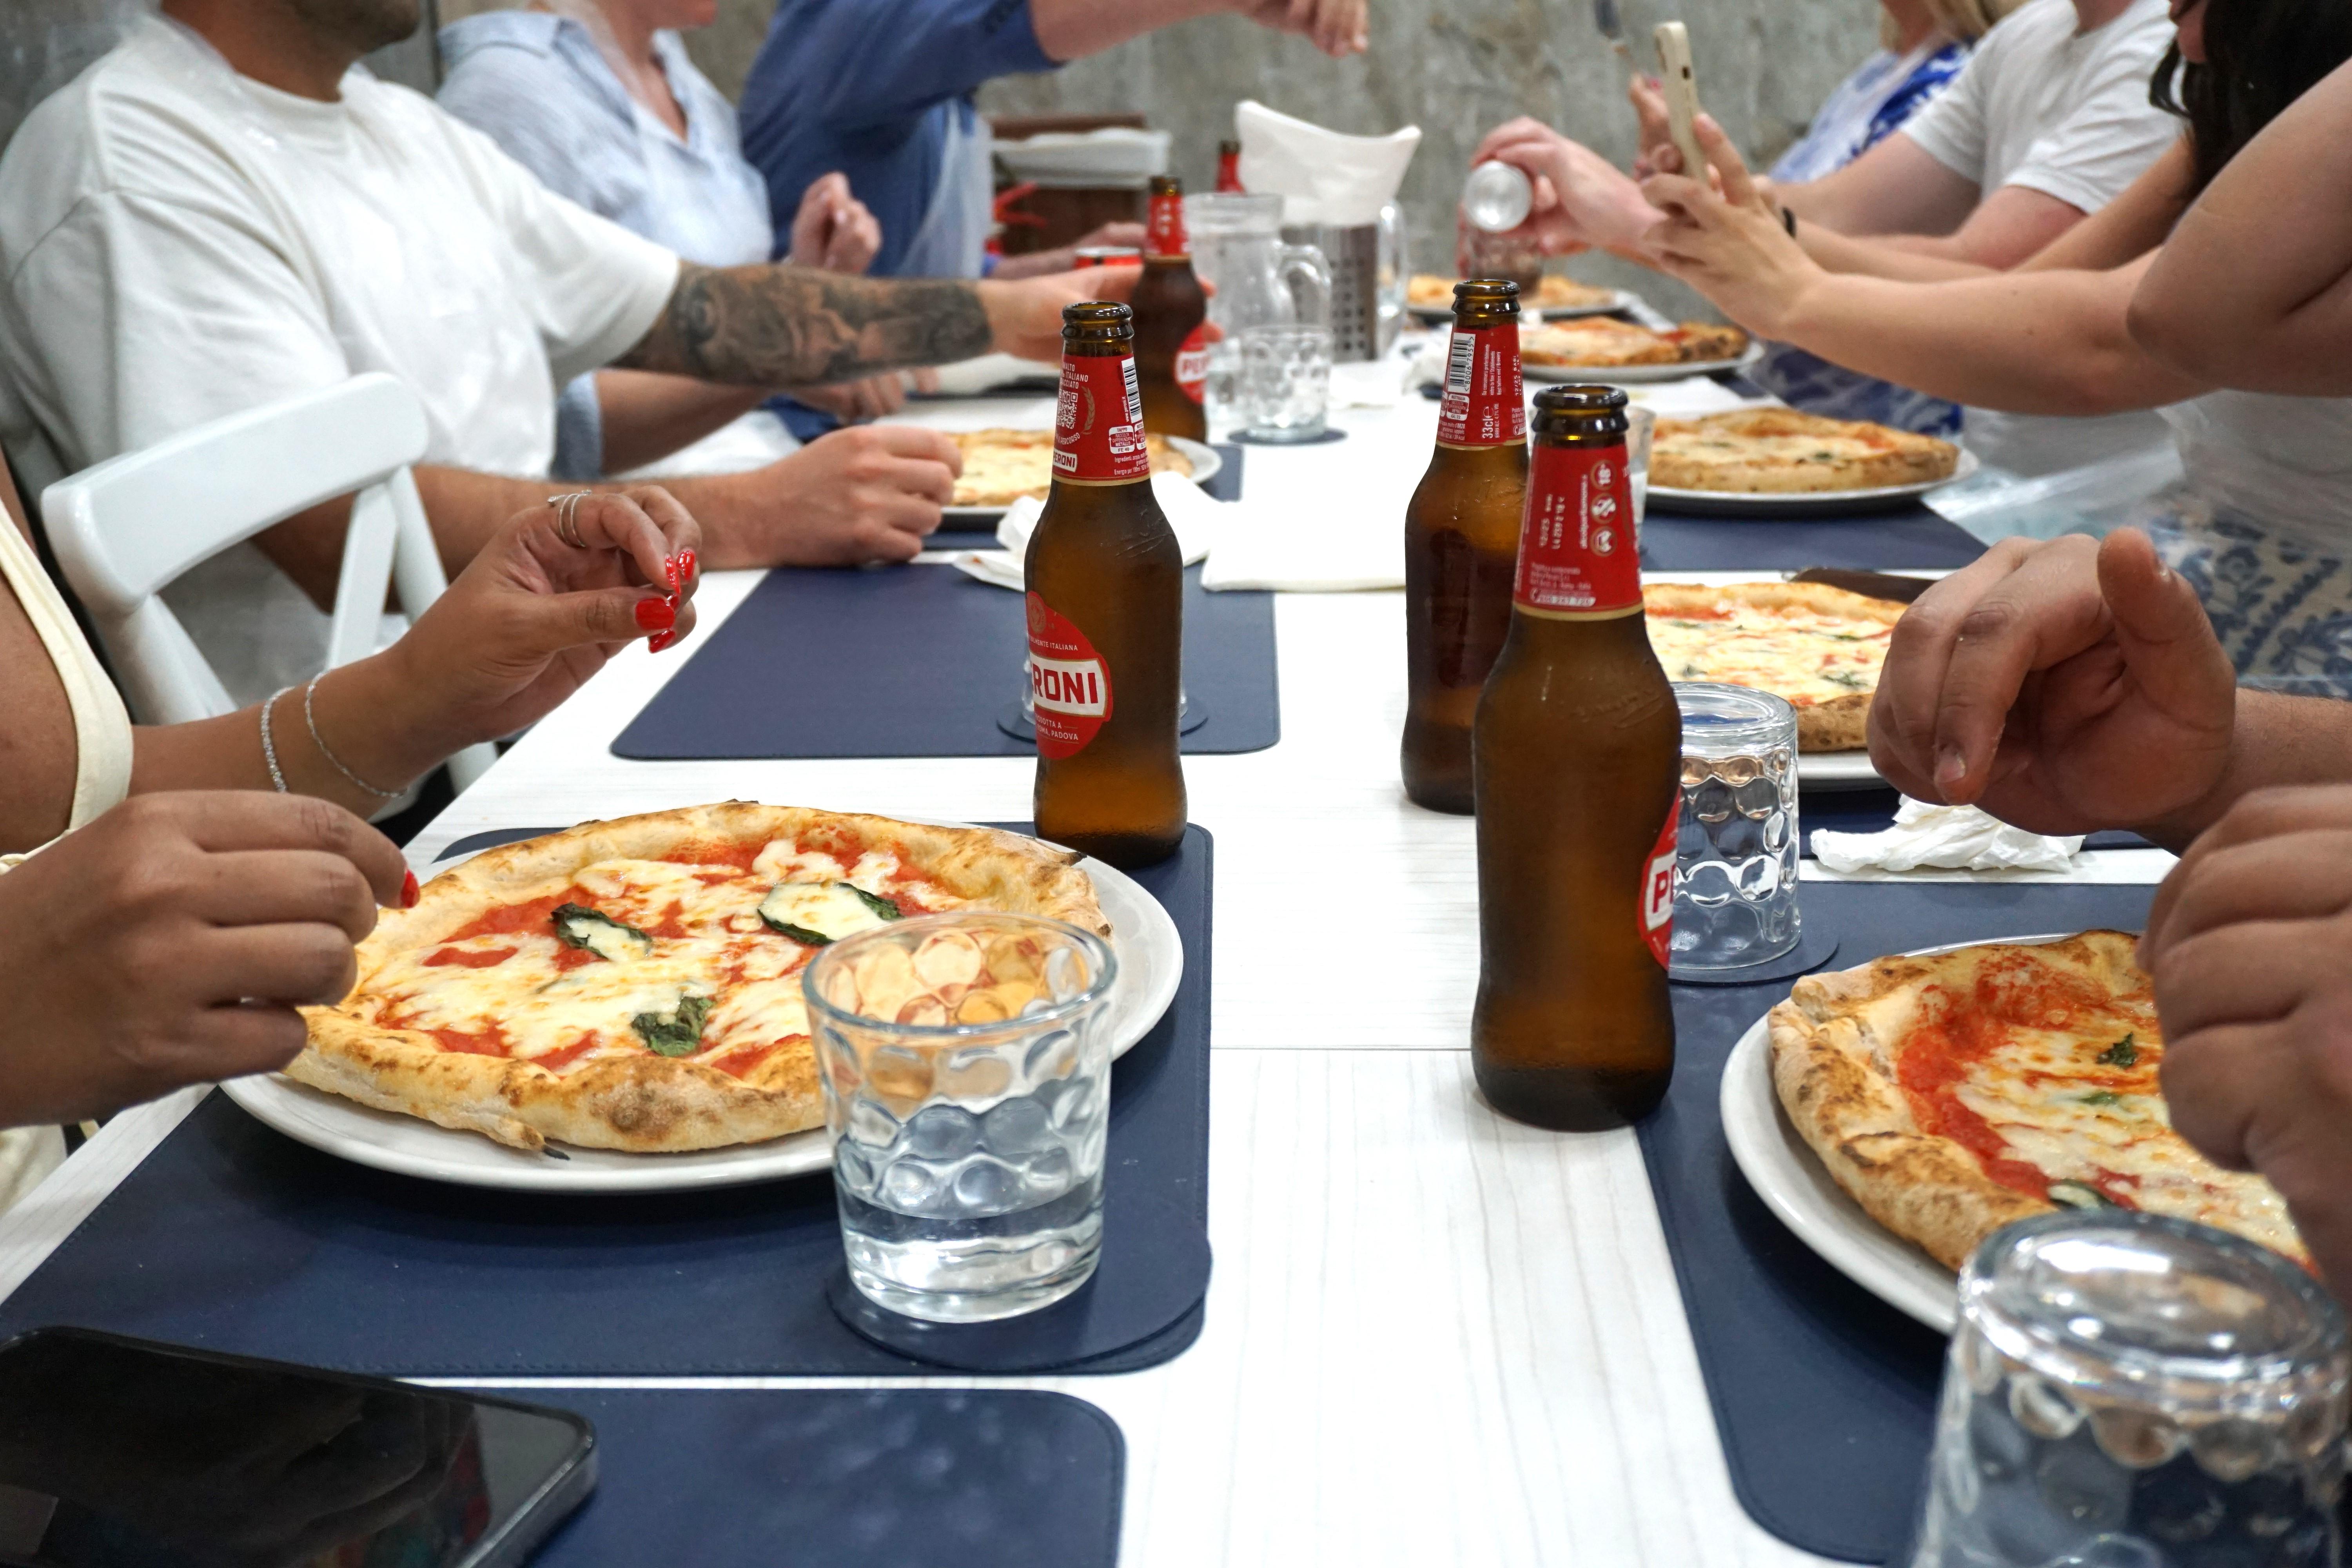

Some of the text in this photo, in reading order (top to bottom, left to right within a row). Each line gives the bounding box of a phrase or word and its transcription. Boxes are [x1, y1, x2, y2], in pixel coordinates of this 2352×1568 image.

[1066, 371, 1089, 383] ITALIANO
[1060, 432, 1080, 445] PERCORSO
[1050, 642, 1078, 651] ITALIANA
[1031, 662, 1098, 704] RONI
[1051, 730, 1078, 740] PADOVA
